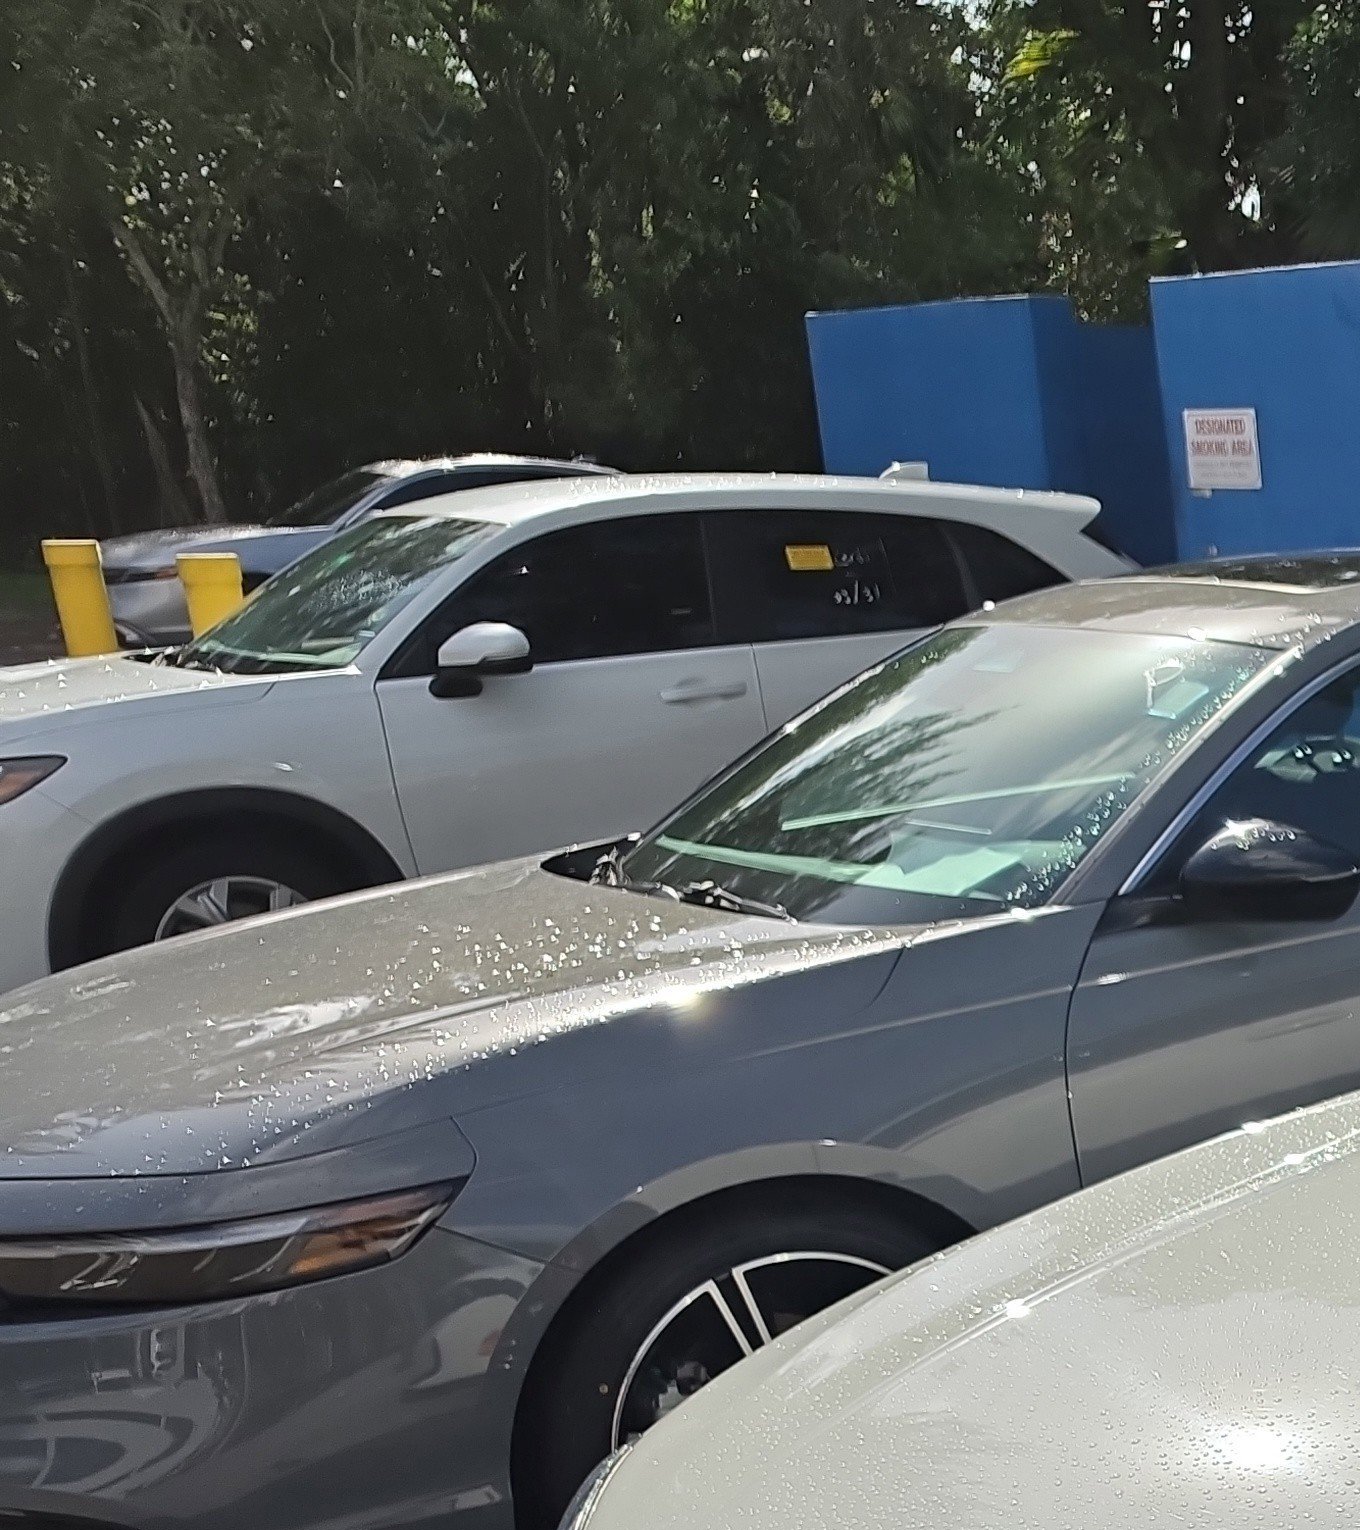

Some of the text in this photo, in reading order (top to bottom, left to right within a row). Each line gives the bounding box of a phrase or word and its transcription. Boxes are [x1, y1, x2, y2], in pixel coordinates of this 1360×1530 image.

[1195, 418, 1246, 435] DESIGNATED
[1191, 439, 1253, 457] SMOKING AREA
